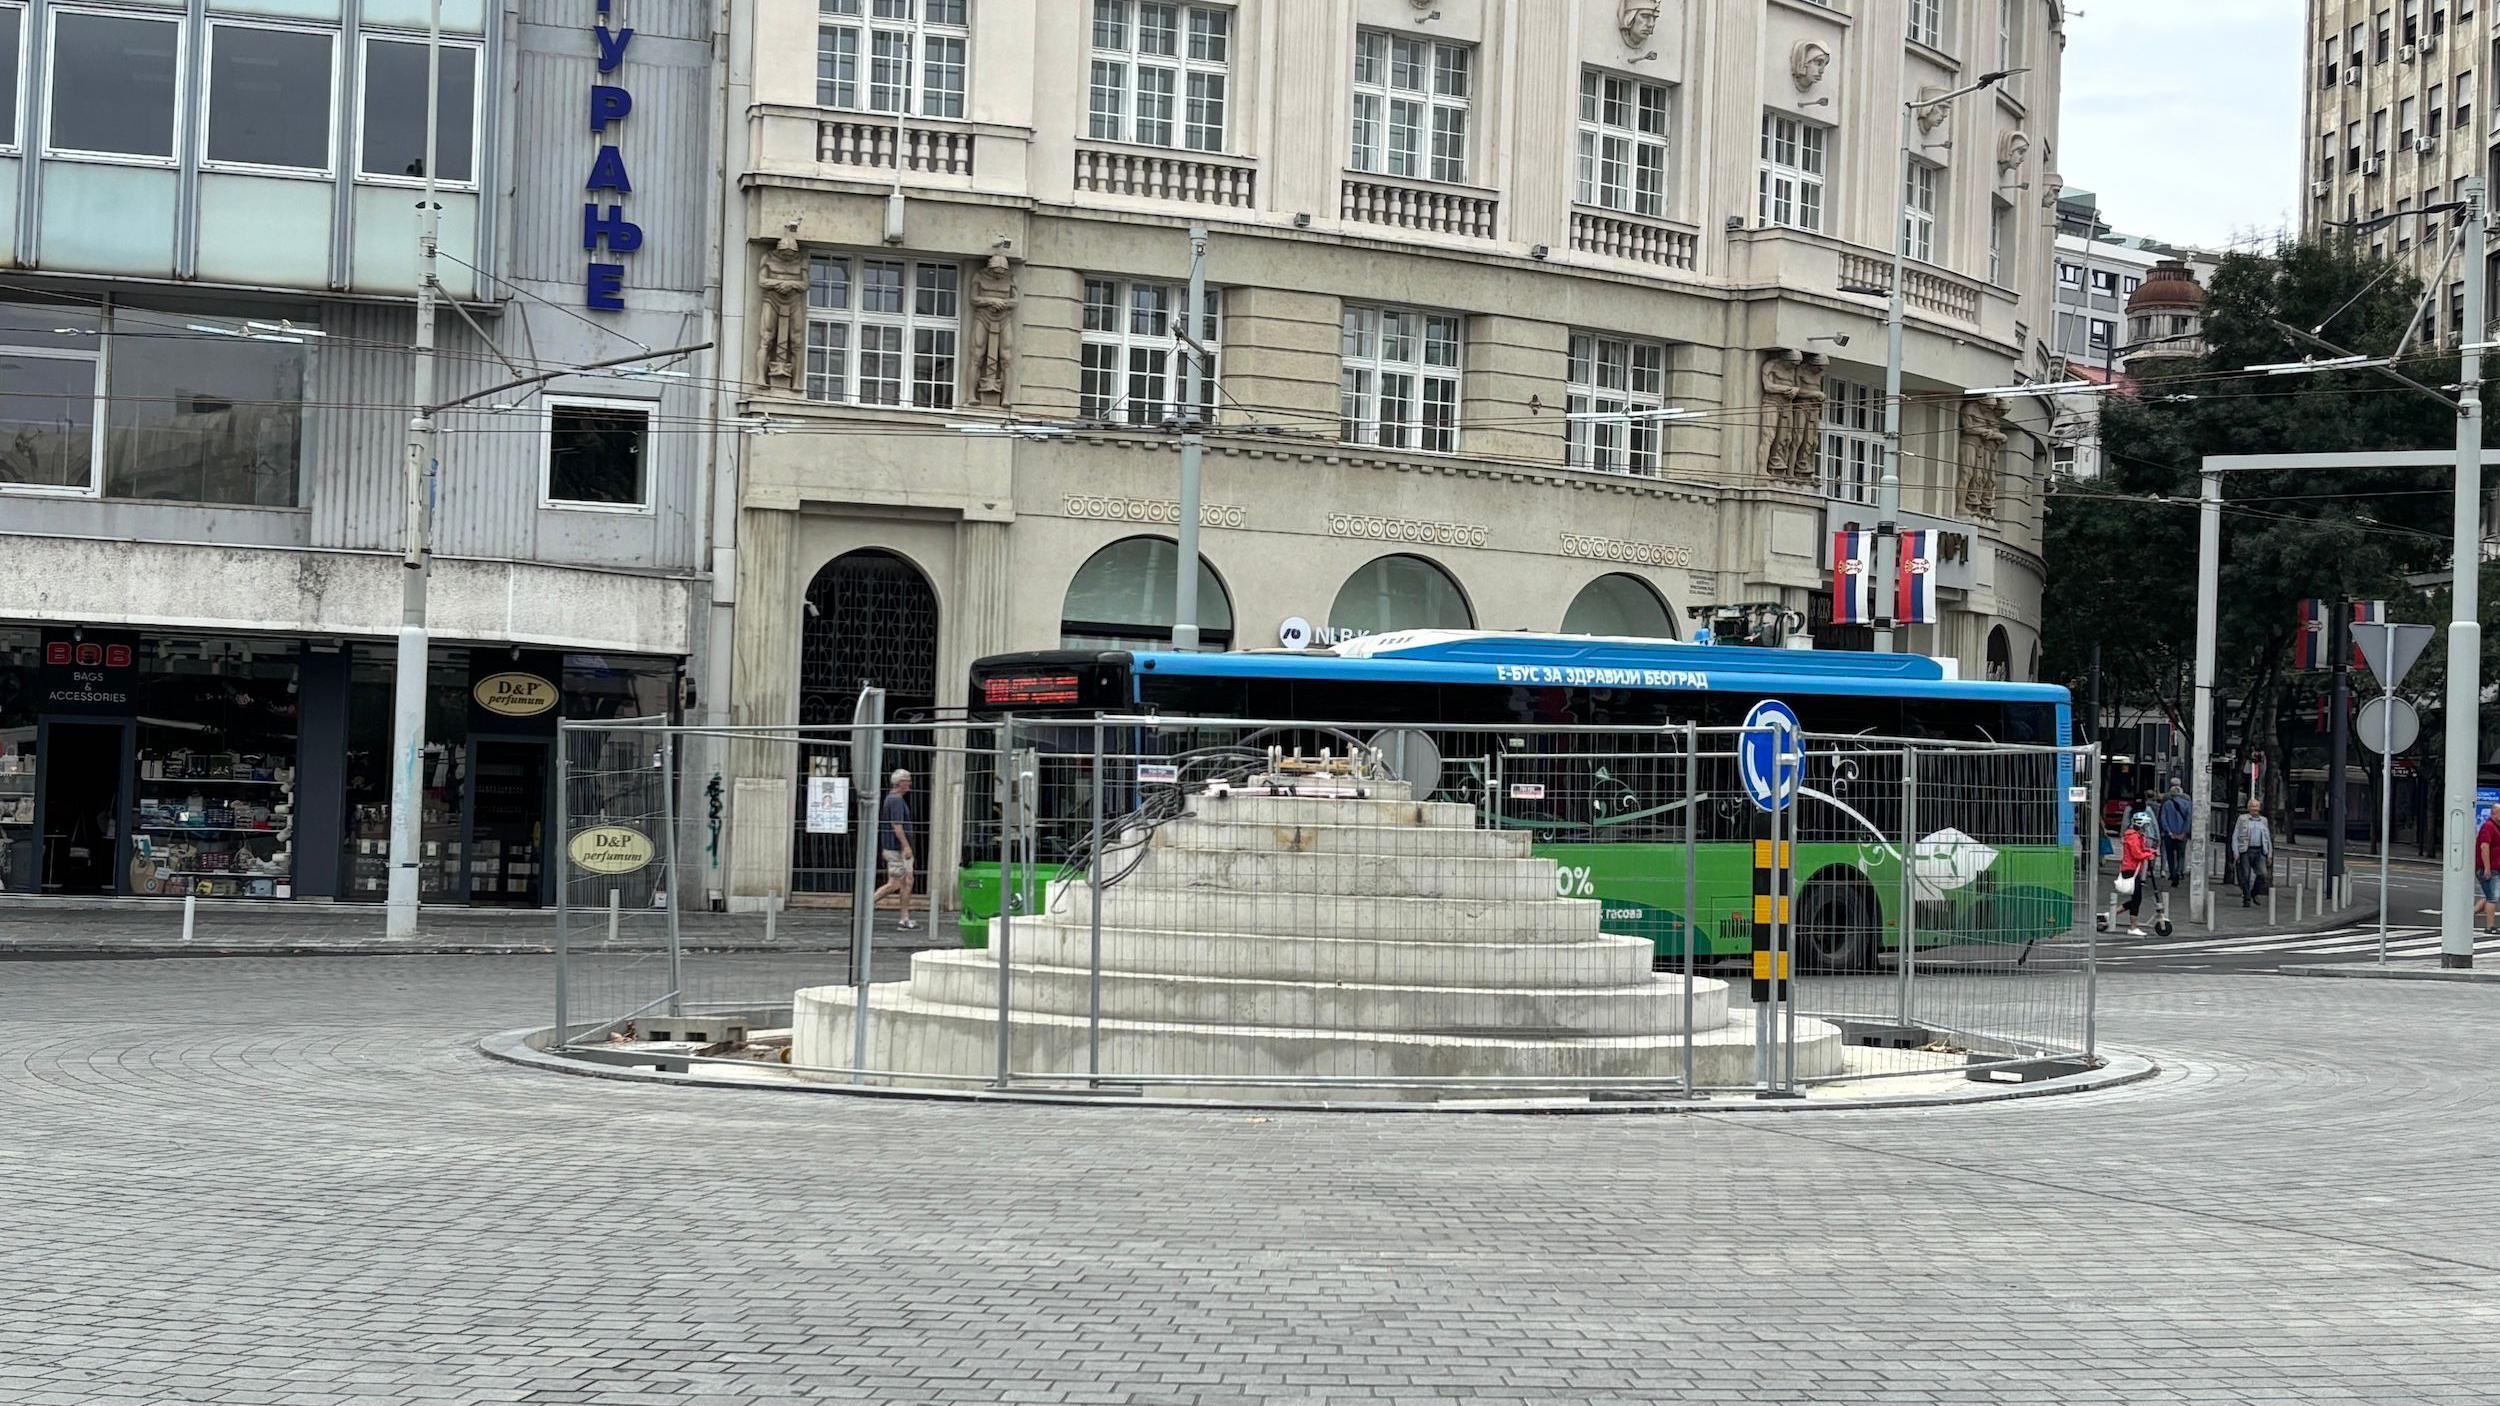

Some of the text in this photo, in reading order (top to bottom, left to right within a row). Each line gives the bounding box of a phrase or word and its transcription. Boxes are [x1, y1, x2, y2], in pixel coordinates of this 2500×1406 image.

[584, 0, 643, 311] УРАЊЕ
[47, 641, 132, 667] BOB
[73, 671, 104, 681] BAGS
[1544, 668, 1563, 683] ЗА
[1566, 669, 1641, 685] ЗДРАВИЈИ
[1645, 671, 1709, 689] БЕОГРАД
[84, 682, 92, 691] &
[49, 691, 127, 703] ACCESSORIES
[488, 695, 544, 705] perfumum
[583, 850, 642, 863] perfumum
[1606, 909, 1642, 919] гасова
